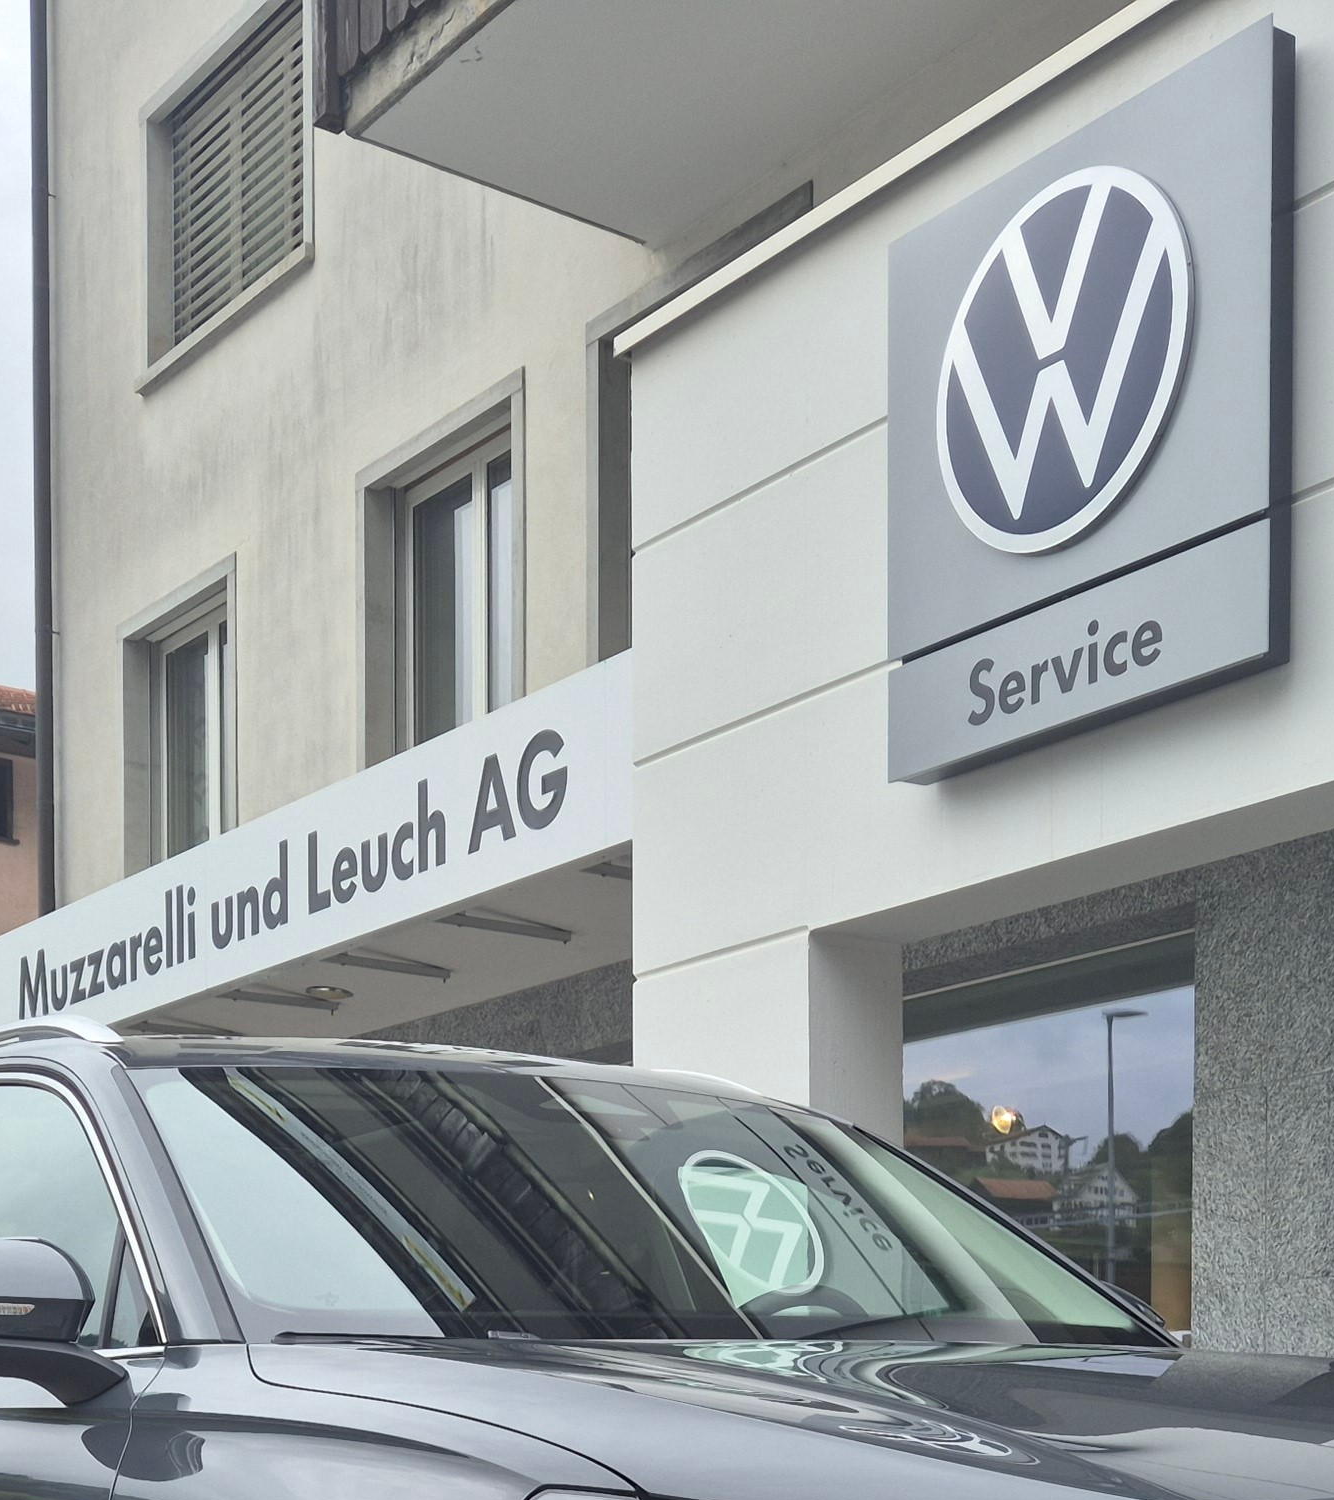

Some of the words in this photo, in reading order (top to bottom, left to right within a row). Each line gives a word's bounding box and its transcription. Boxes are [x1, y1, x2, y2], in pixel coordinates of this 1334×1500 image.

[966, 618, 1164, 727] Service
[18, 883, 197, 1020] Muzzarelli
[211, 839, 289, 949] und
[307, 779, 446, 913] Leuch
[467, 728, 569, 856] AG
